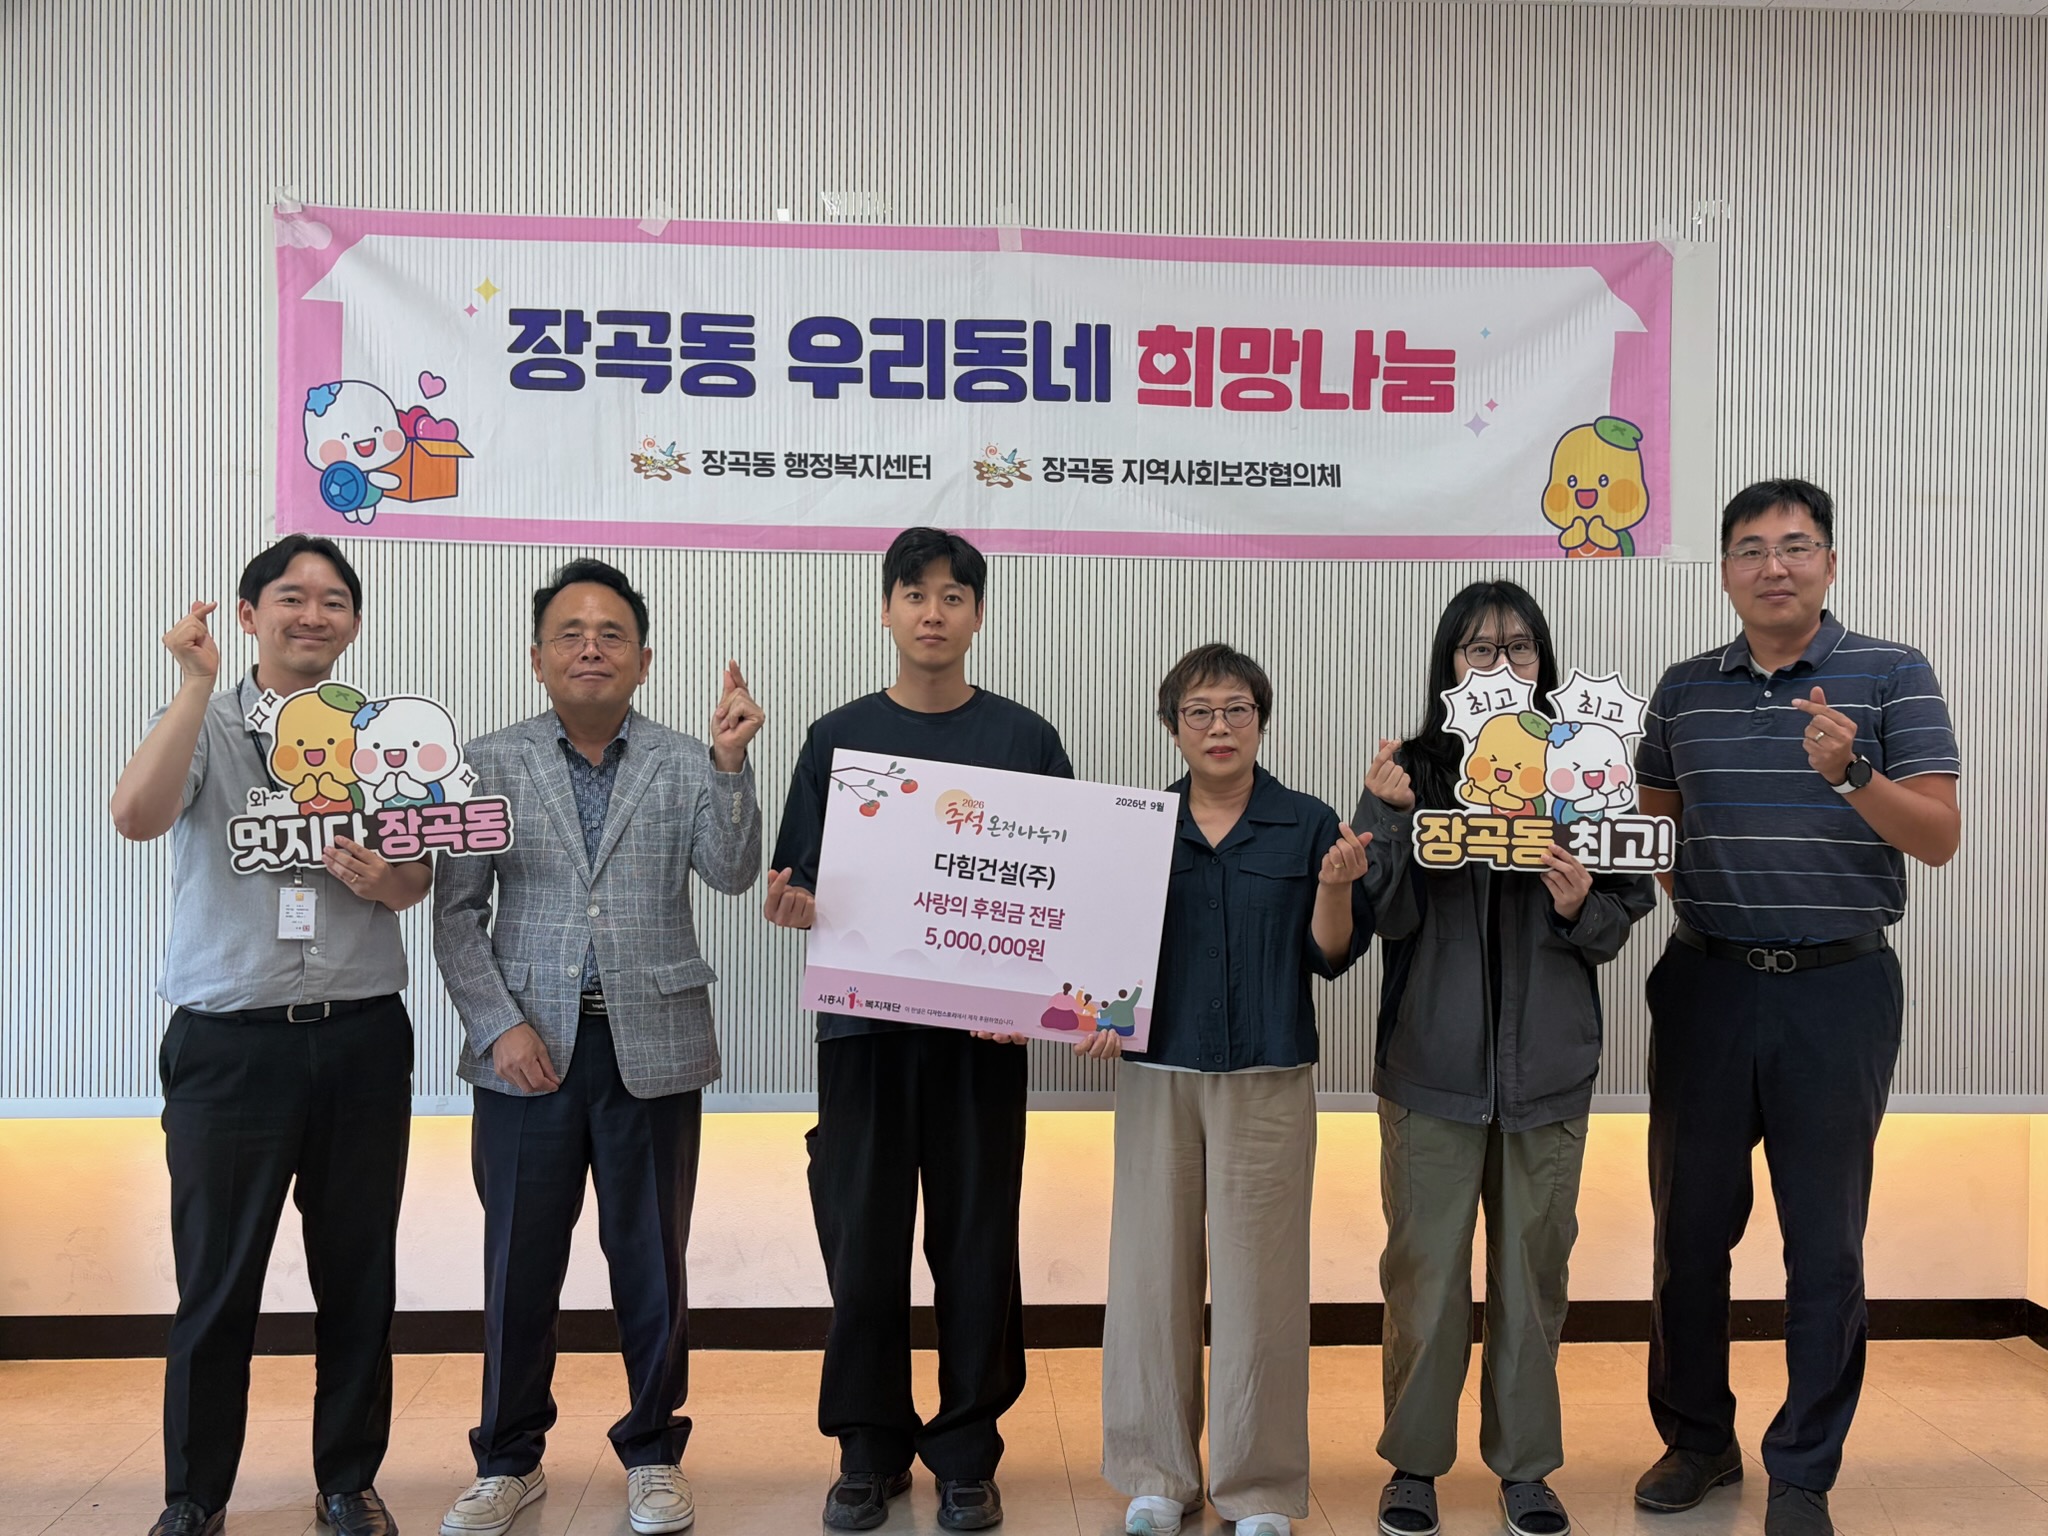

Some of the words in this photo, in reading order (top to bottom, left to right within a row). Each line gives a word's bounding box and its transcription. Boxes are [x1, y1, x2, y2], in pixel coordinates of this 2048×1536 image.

[507, 308, 757, 398] 장곡동
[787, 316, 1112, 404] 우리동네
[1137, 324, 1456, 414] 희망나눔
[701, 450, 777, 477] 장곡동
[783, 452, 932, 481] 행정복지센터
[1042, 456, 1114, 484] 장곡동
[1120, 459, 1342, 488] 지역사회보장협의체
[1466, 688, 1518, 715] 최고
[1577, 690, 1624, 723] 최고
[945, 802, 985, 836] 추석
[962, 798, 985, 809] 2026
[1115, 797, 1147, 810] 2026년
[1150, 801, 1165, 813] 9월
[233, 812, 369, 869] 멋지다
[376, 801, 507, 856] 장곡동
[1419, 816, 1555, 864] 장곡동
[1568, 821, 1670, 867] 최고!
[934, 853, 1056, 890] 다힘건설(주)
[913, 891, 968, 918] 사랑의
[970, 897, 1025, 925] 후원금
[1029, 905, 1065, 930] 전달
[924, 927, 1045, 962] 5,000,000원
[818, 993, 845, 1006] 시흥시
[865, 999, 901, 1013] 복지재단
